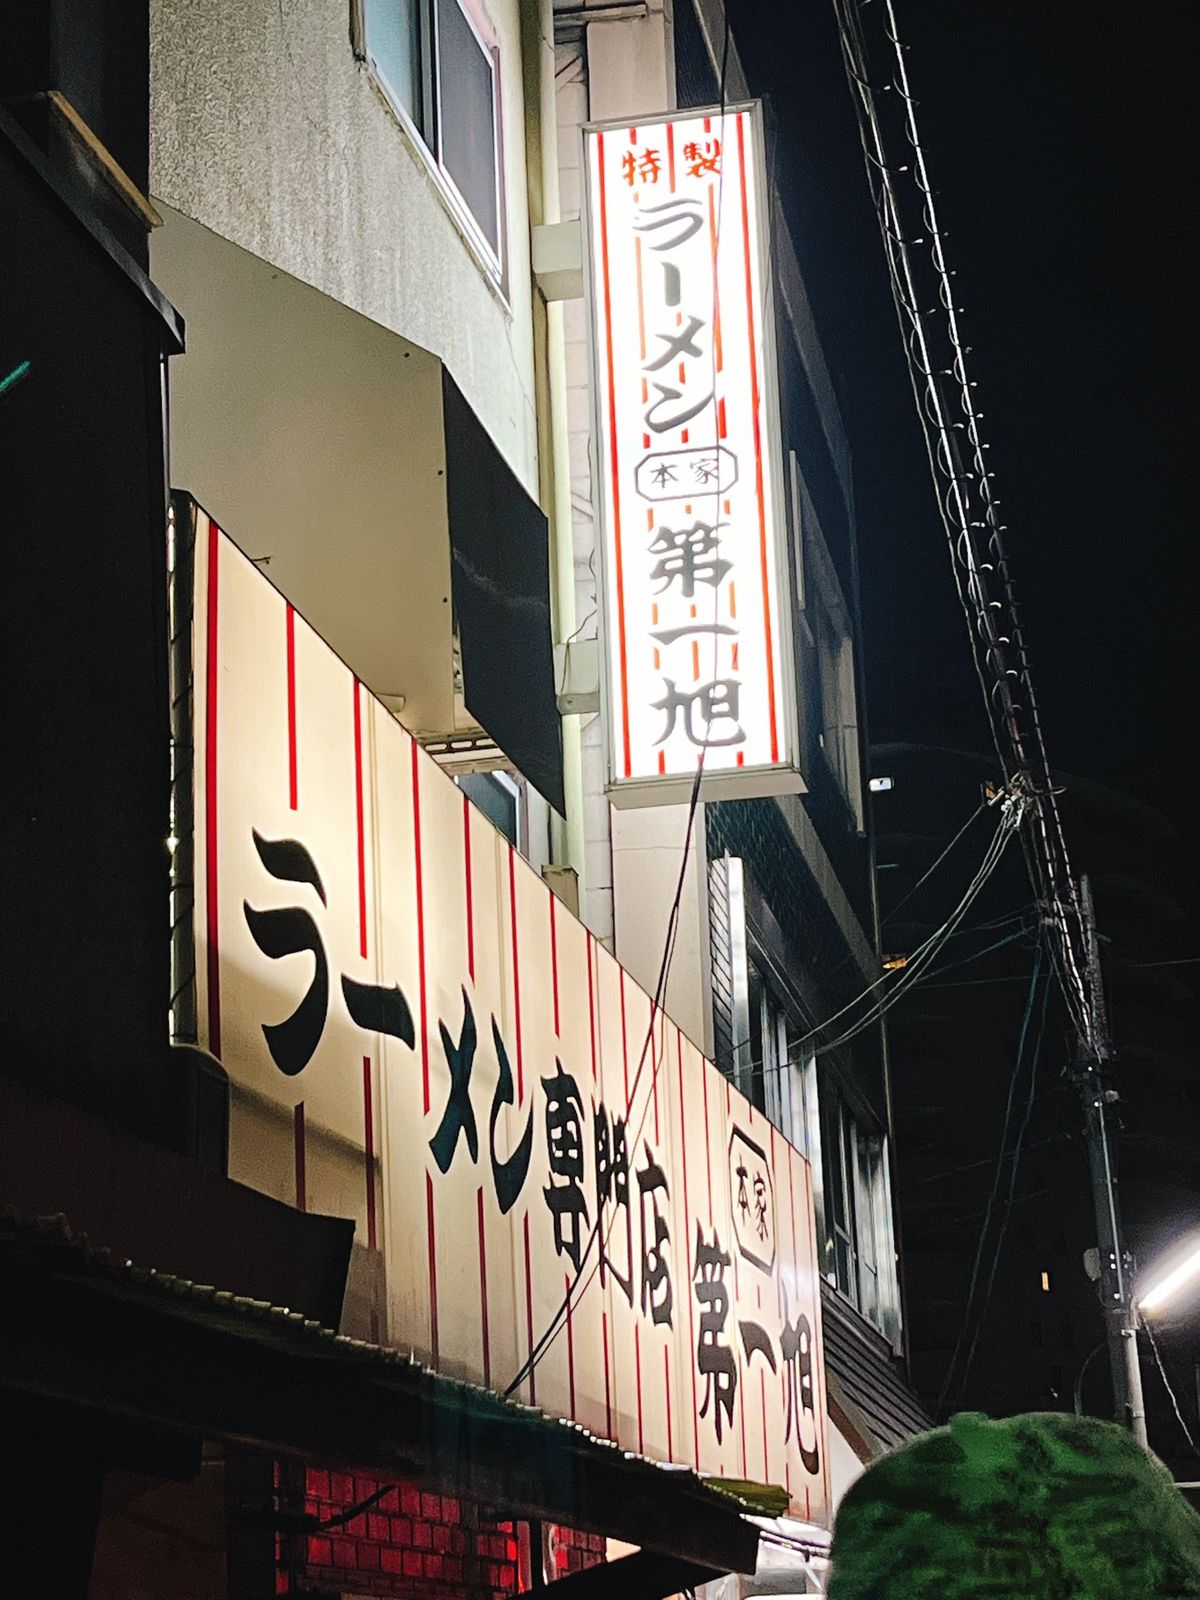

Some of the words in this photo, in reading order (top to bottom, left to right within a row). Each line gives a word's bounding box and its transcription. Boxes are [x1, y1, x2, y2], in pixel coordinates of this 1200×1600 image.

[621, 138, 722, 187] 特製
[631, 198, 715, 433] ラーメン
[650, 458, 720, 488] 本家
[647, 520, 748, 747] 第一旭
[736, 1153, 770, 1242] 本家
[693, 1217, 819, 1475] 第一旭
